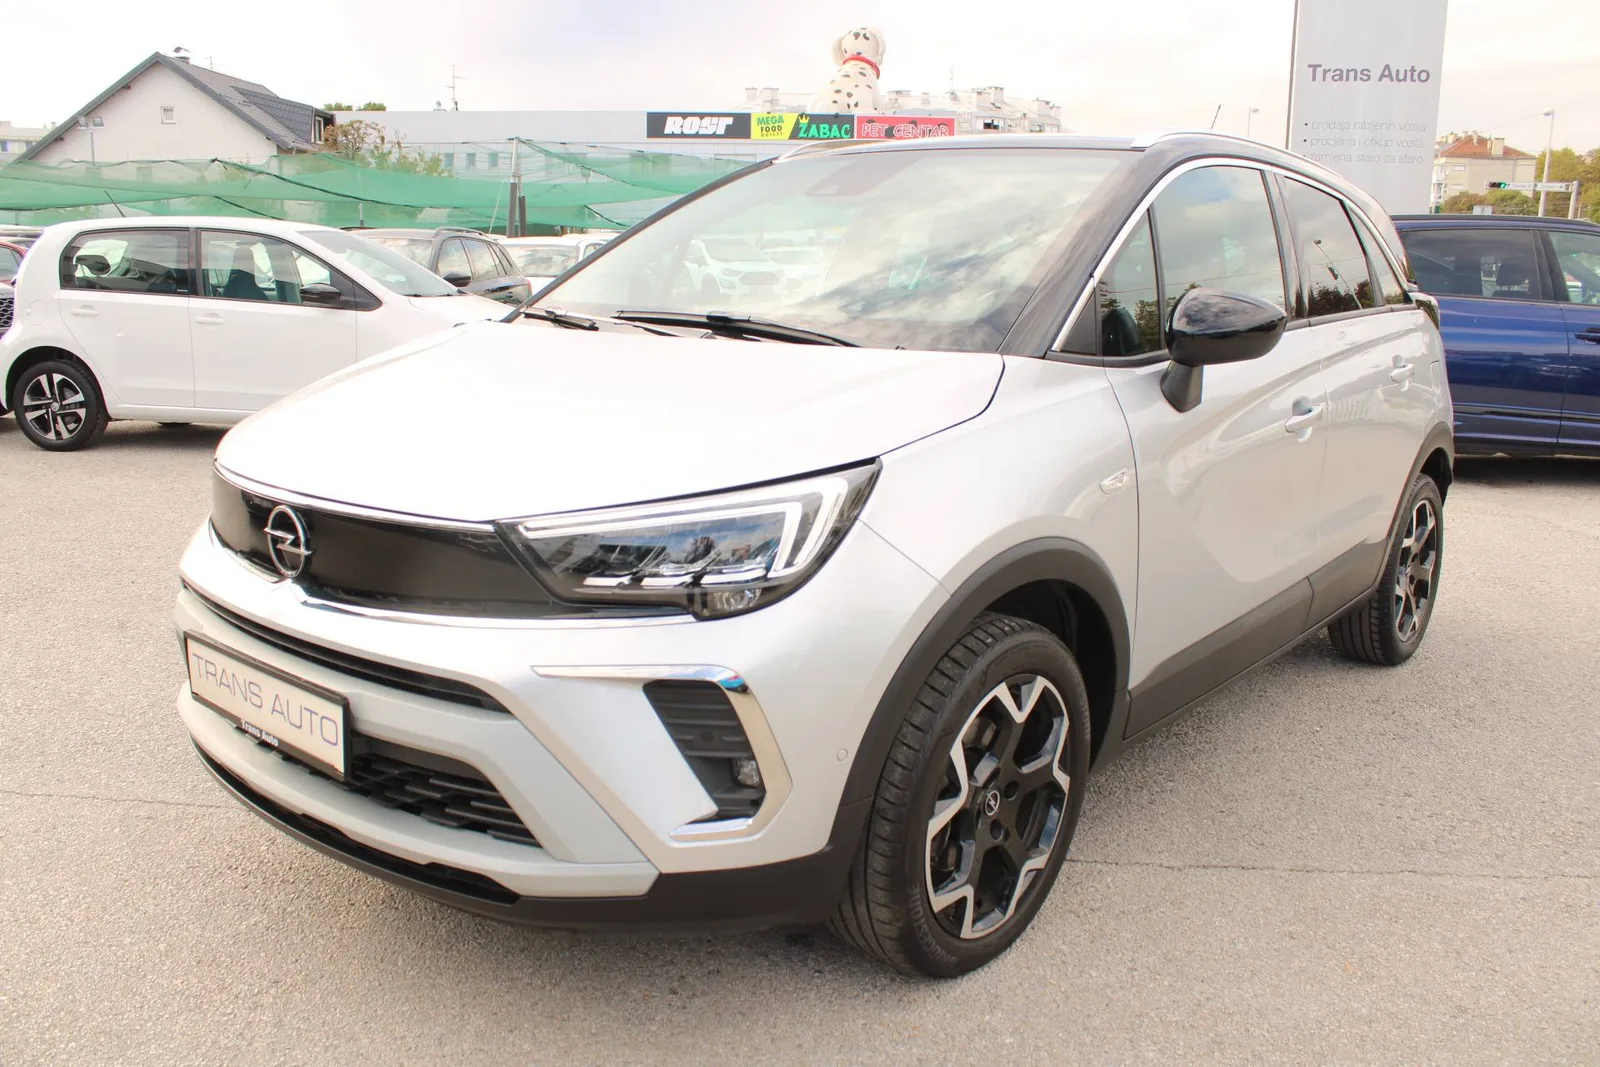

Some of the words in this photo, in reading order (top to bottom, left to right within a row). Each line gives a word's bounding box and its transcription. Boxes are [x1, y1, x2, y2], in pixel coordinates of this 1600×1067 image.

[1307, 64, 1371, 82] Trans
[1377, 64, 1430, 83] Auto
[757, 115, 784, 126] MEGA
[1311, 120, 1351, 132] prodaja
[760, 125, 783, 133] FOOD
[861, 122, 889, 136] PET
[892, 123, 949, 138] CENTAR
[1355, 152, 1381, 163] staro
[1383, 155, 1395, 163] za
[192, 652, 263, 709] TRANS
[271, 693, 338, 747] AUTO
[240, 718, 261, 738] Trans
[261, 730, 279, 747] Auto
